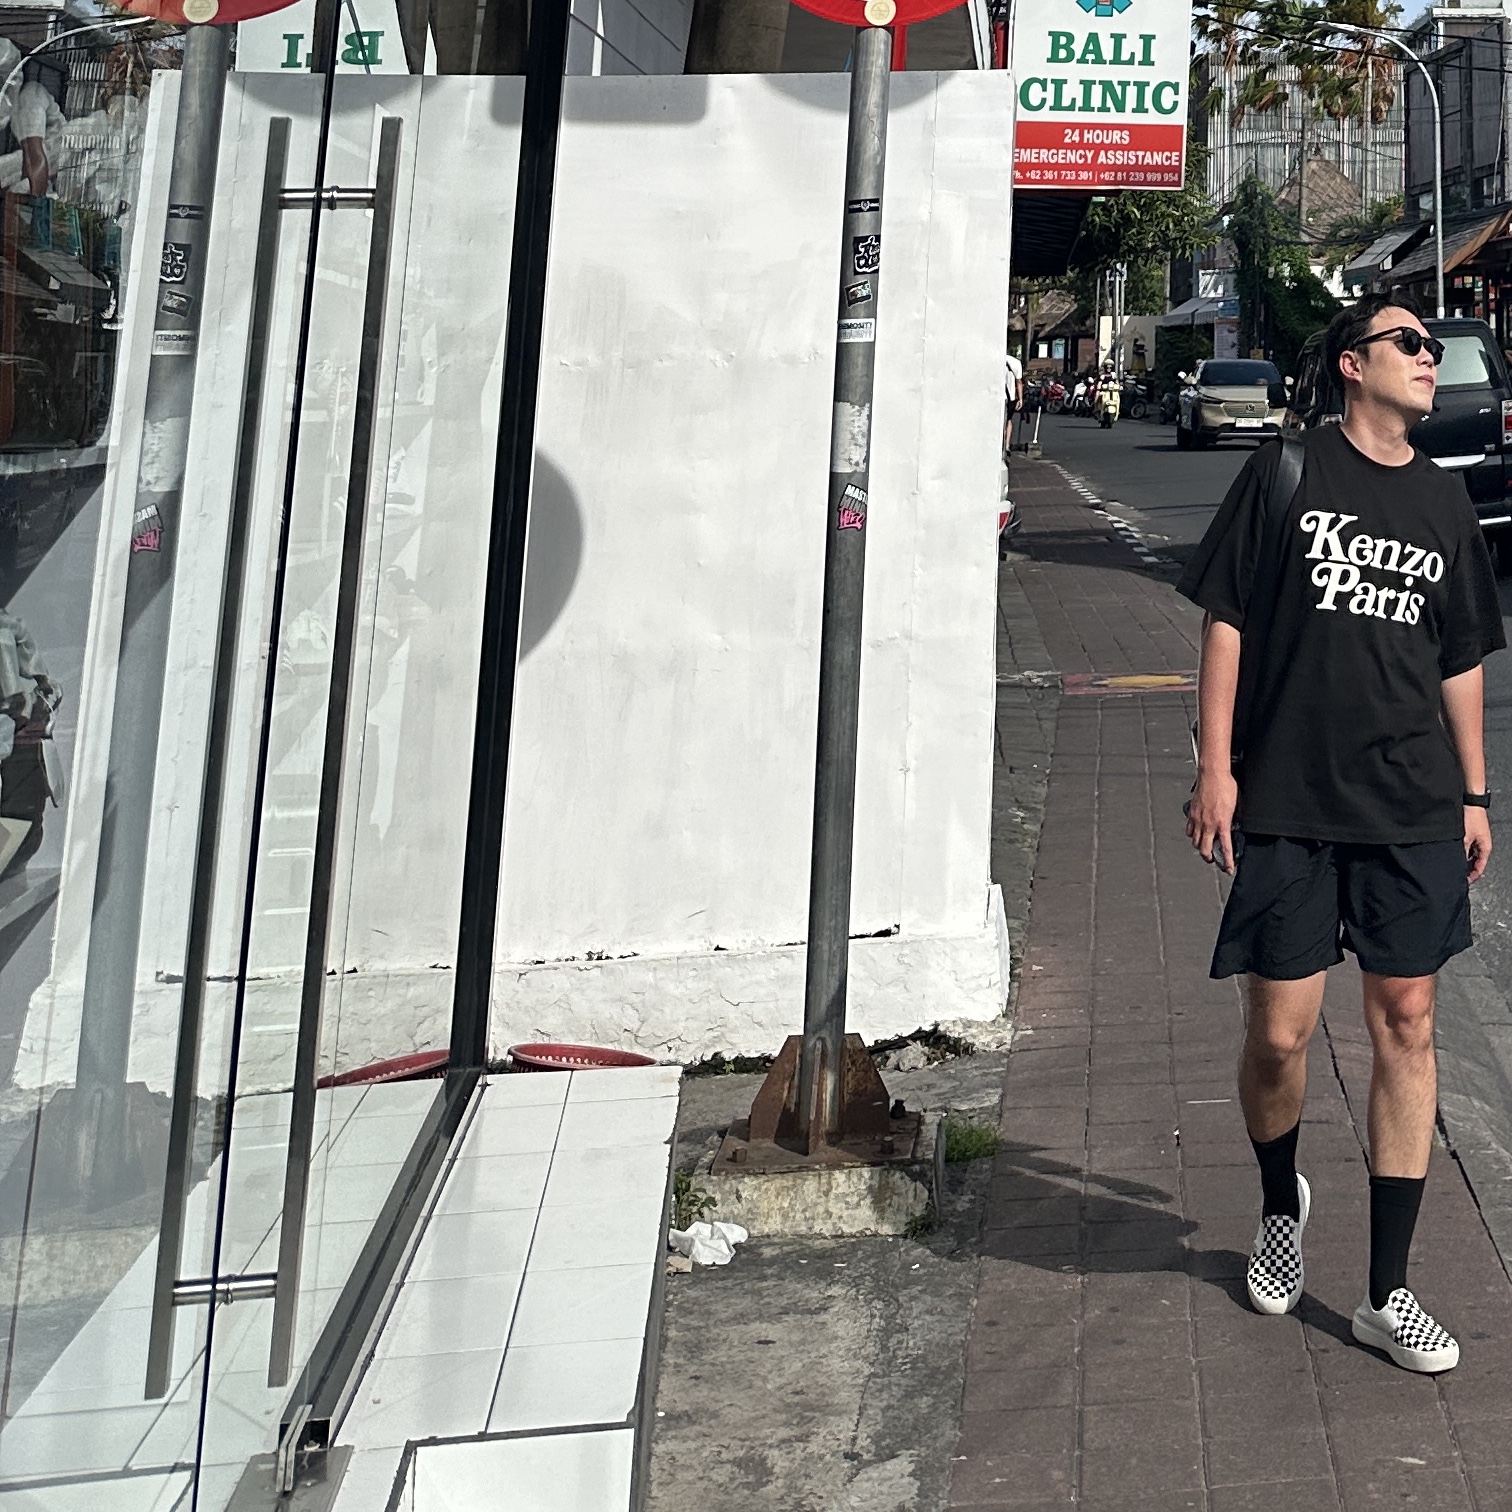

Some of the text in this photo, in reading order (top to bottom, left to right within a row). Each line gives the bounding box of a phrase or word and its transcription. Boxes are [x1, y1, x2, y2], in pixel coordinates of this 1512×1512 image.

[1046, 30, 1157, 67] BALI
[1018, 76, 1181, 115] CLINIC
[1063, 128, 1130, 145] 24 HOURS
[1025, 169, 1041, 181] +62
[1060, 170, 1076, 182] 733
[1096, 150, 1180, 166] ASSISTANCE
[1299, 510, 1445, 584] Kenzo
[1311, 561, 1426, 626] Paris
